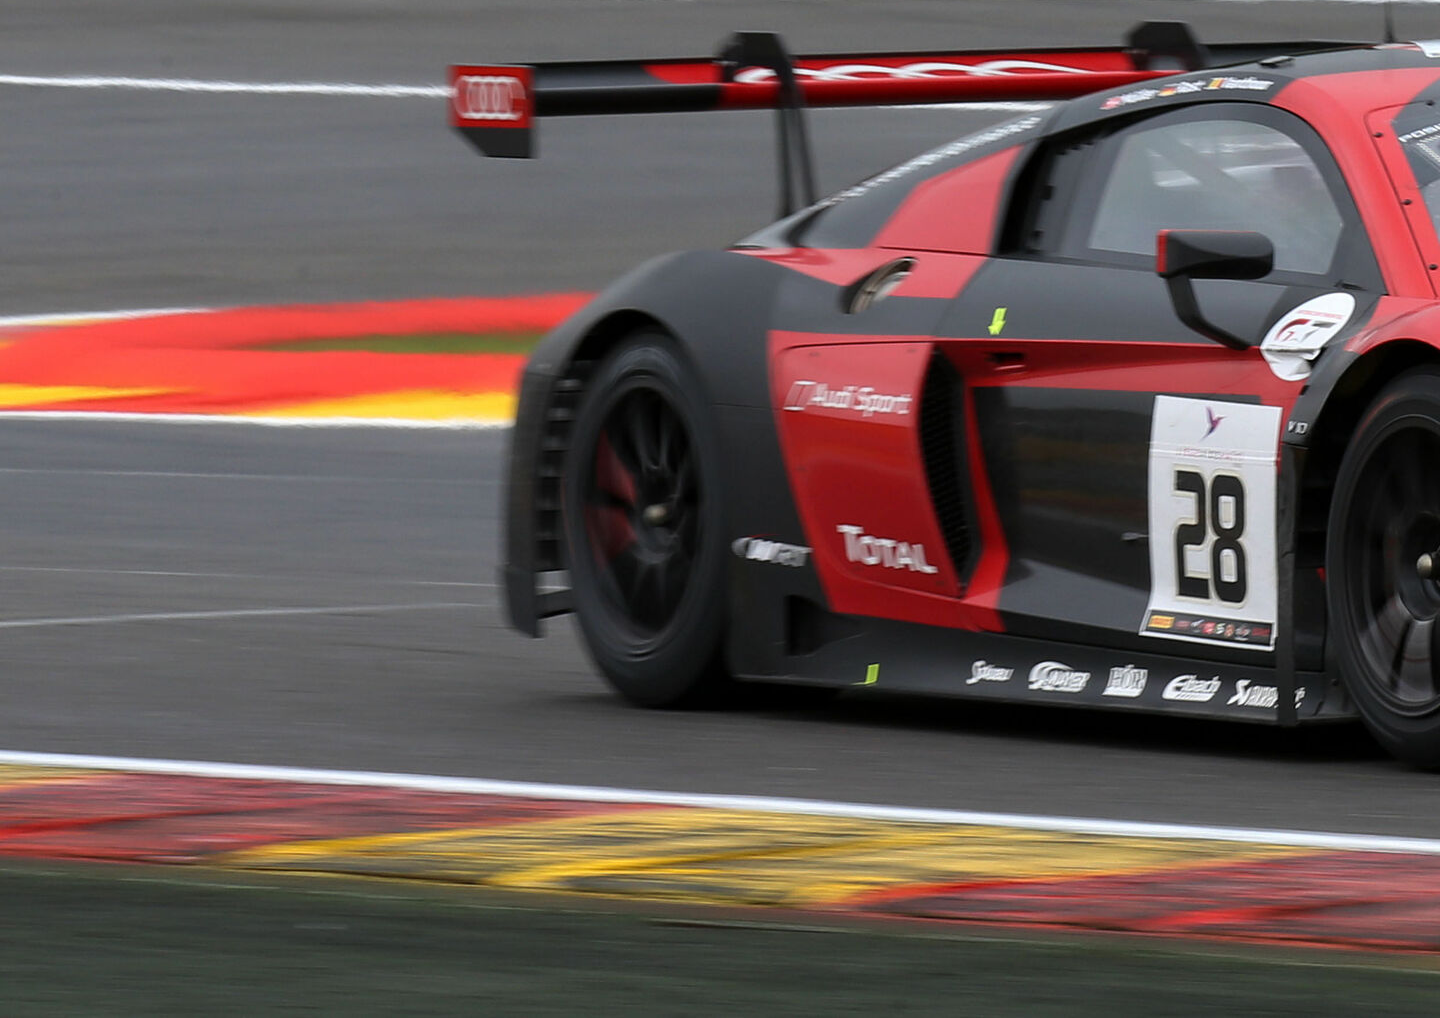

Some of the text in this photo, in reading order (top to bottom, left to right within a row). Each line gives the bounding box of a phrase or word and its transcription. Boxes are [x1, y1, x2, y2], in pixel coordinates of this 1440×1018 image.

[807, 383, 912, 417] Audi Sport
[1175, 469, 1247, 604] 28
